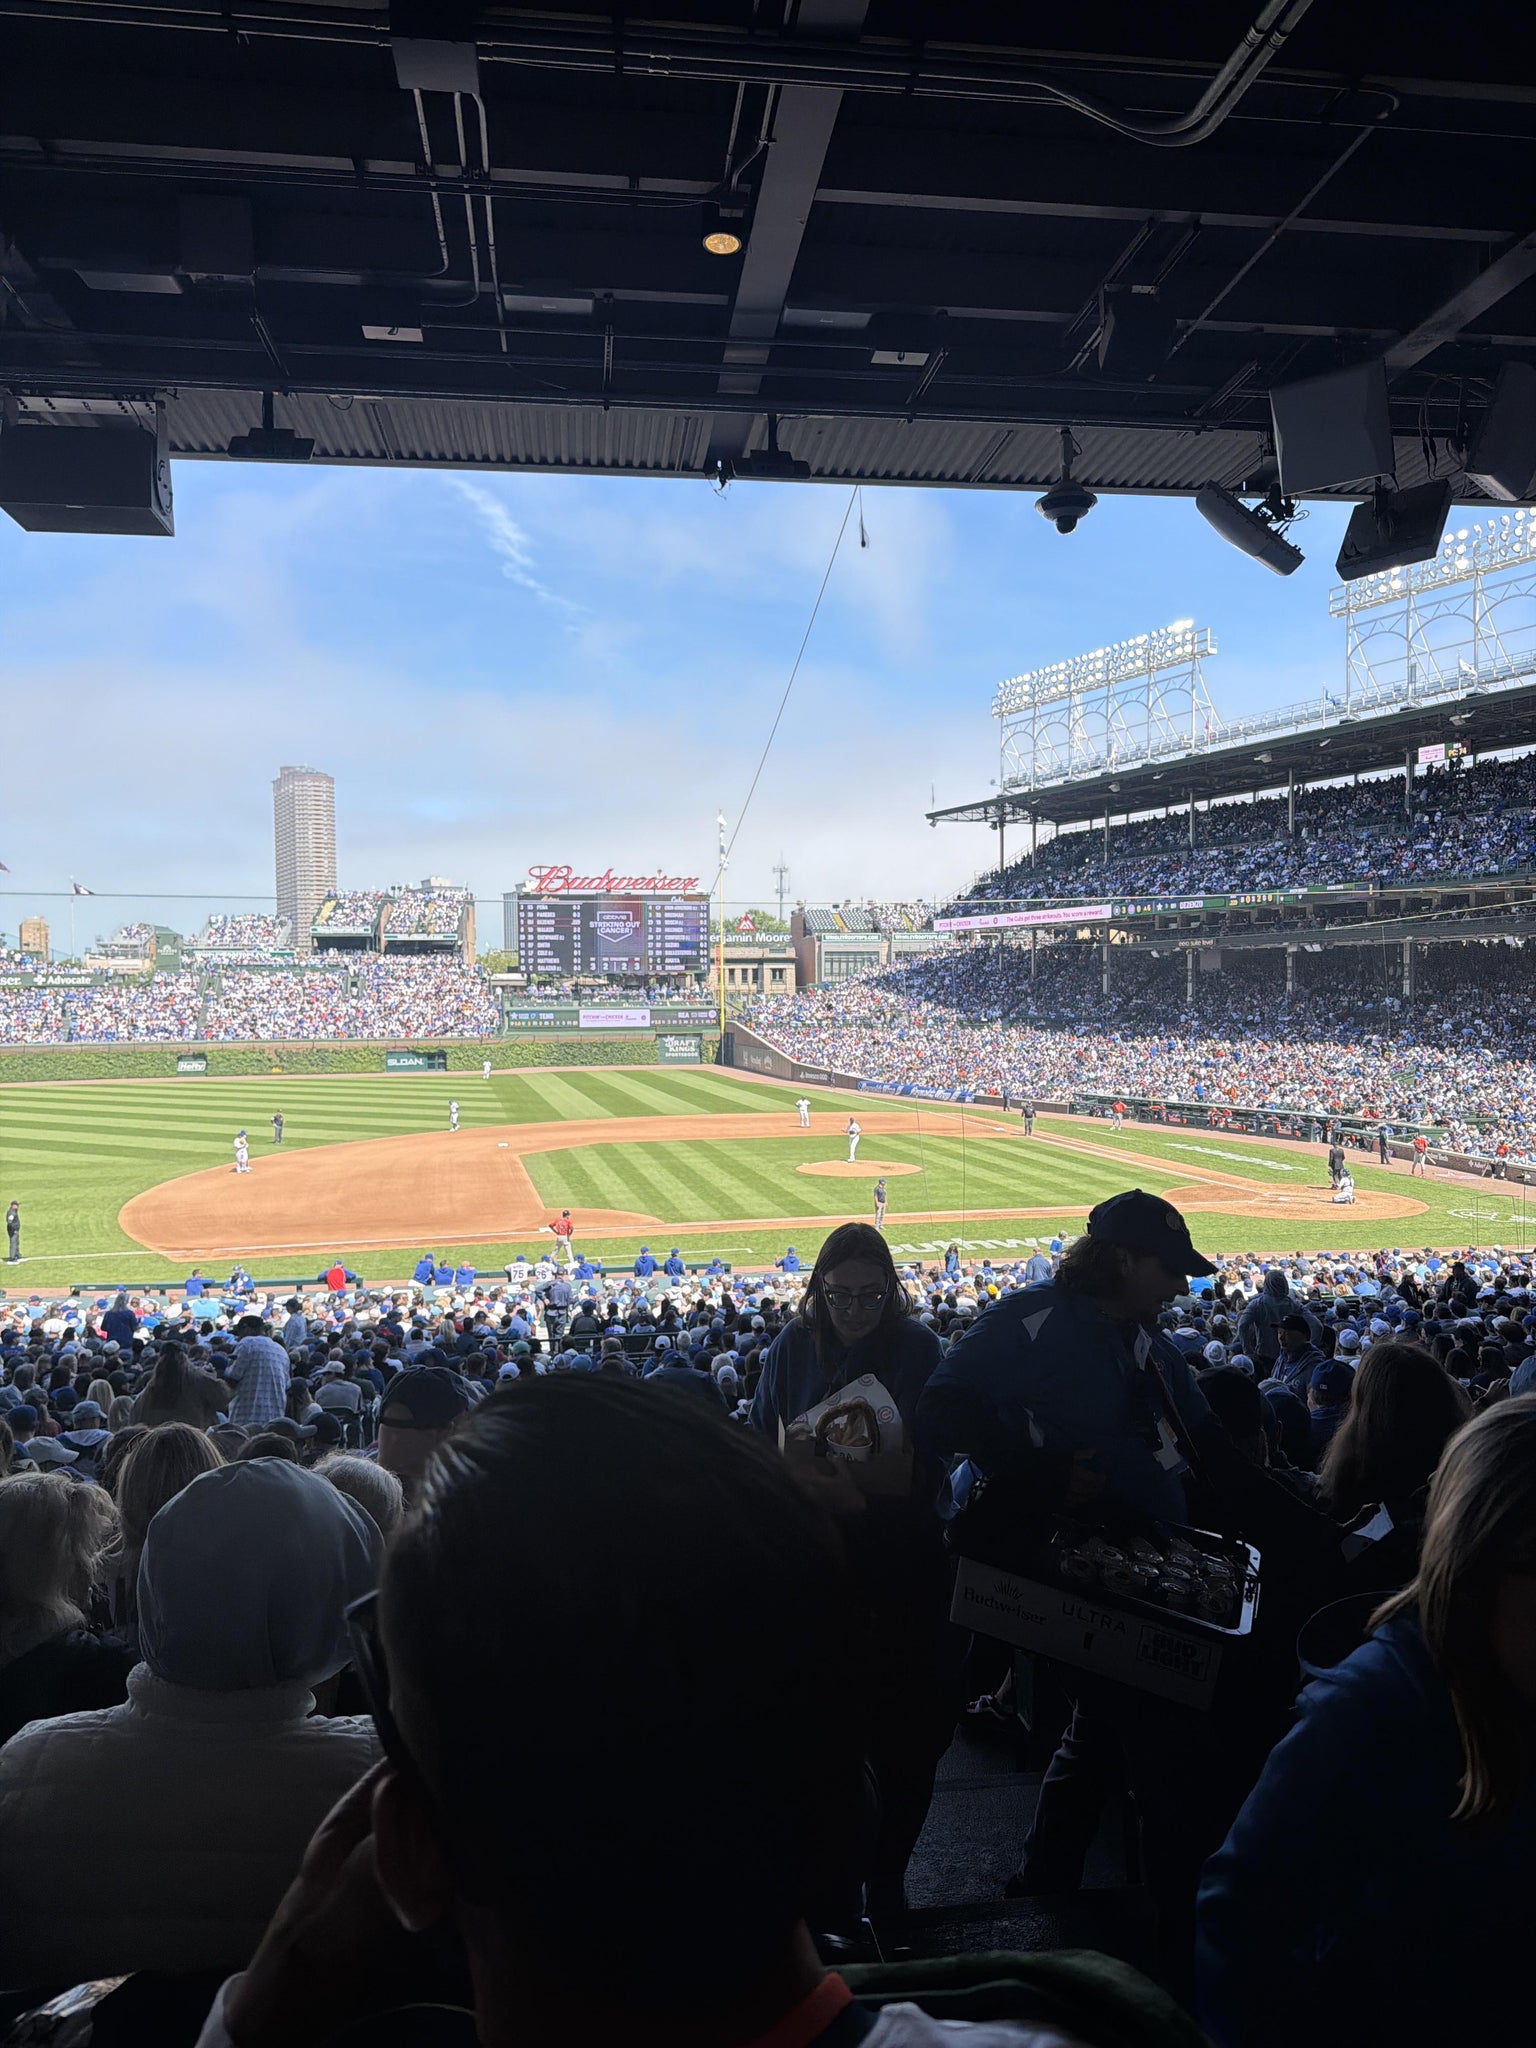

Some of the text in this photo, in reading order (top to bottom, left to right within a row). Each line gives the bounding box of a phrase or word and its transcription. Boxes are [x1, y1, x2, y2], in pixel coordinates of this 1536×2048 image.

[528, 866, 699, 892] Budweiser
[709, 933, 790, 944] enjamin Moore
[47, 975, 91, 985] Advocate
[178, 1061, 206, 1071] Hefty
[513, 1270, 524, 1279] 75
[964, 1586, 1047, 1625] Budweiser
[1061, 1601, 1127, 1635] ULTRA
